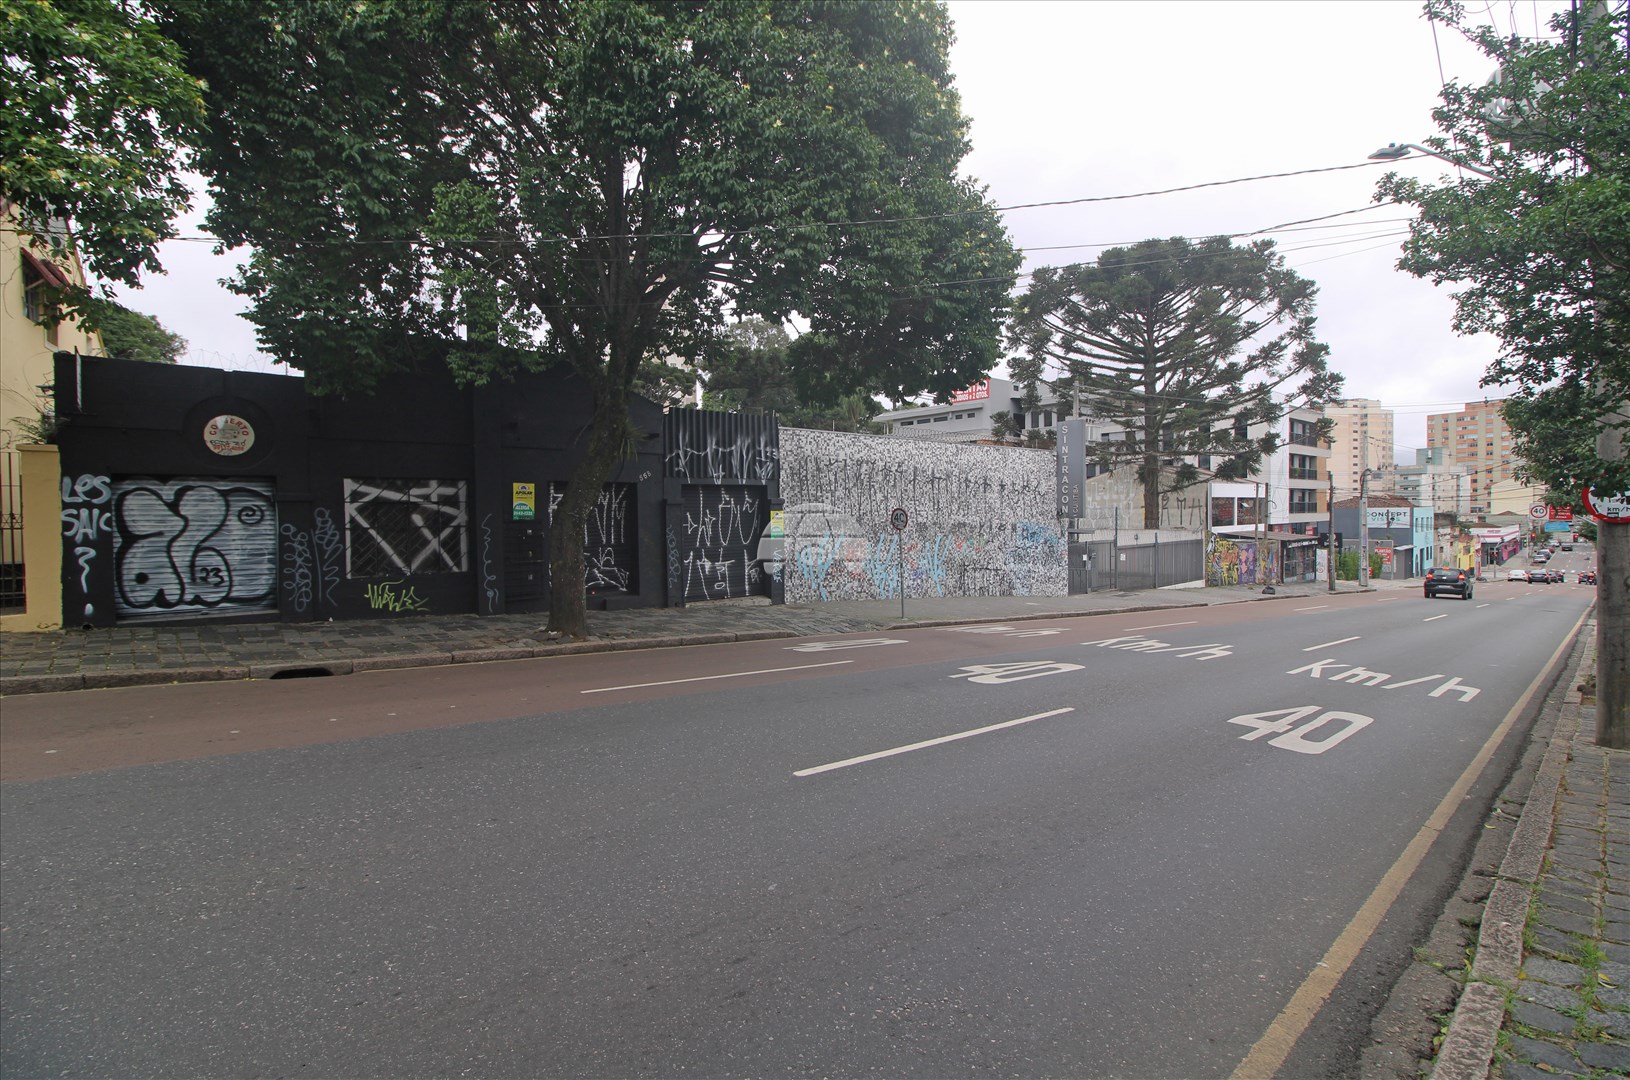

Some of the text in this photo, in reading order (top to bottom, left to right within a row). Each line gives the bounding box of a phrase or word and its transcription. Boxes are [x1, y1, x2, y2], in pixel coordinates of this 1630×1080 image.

[1061, 425, 1069, 514] SINTRACON
[1533, 507, 1545, 515] 40
[947, 660, 1087, 684] 40
[1226, 705, 1374, 755] 40
